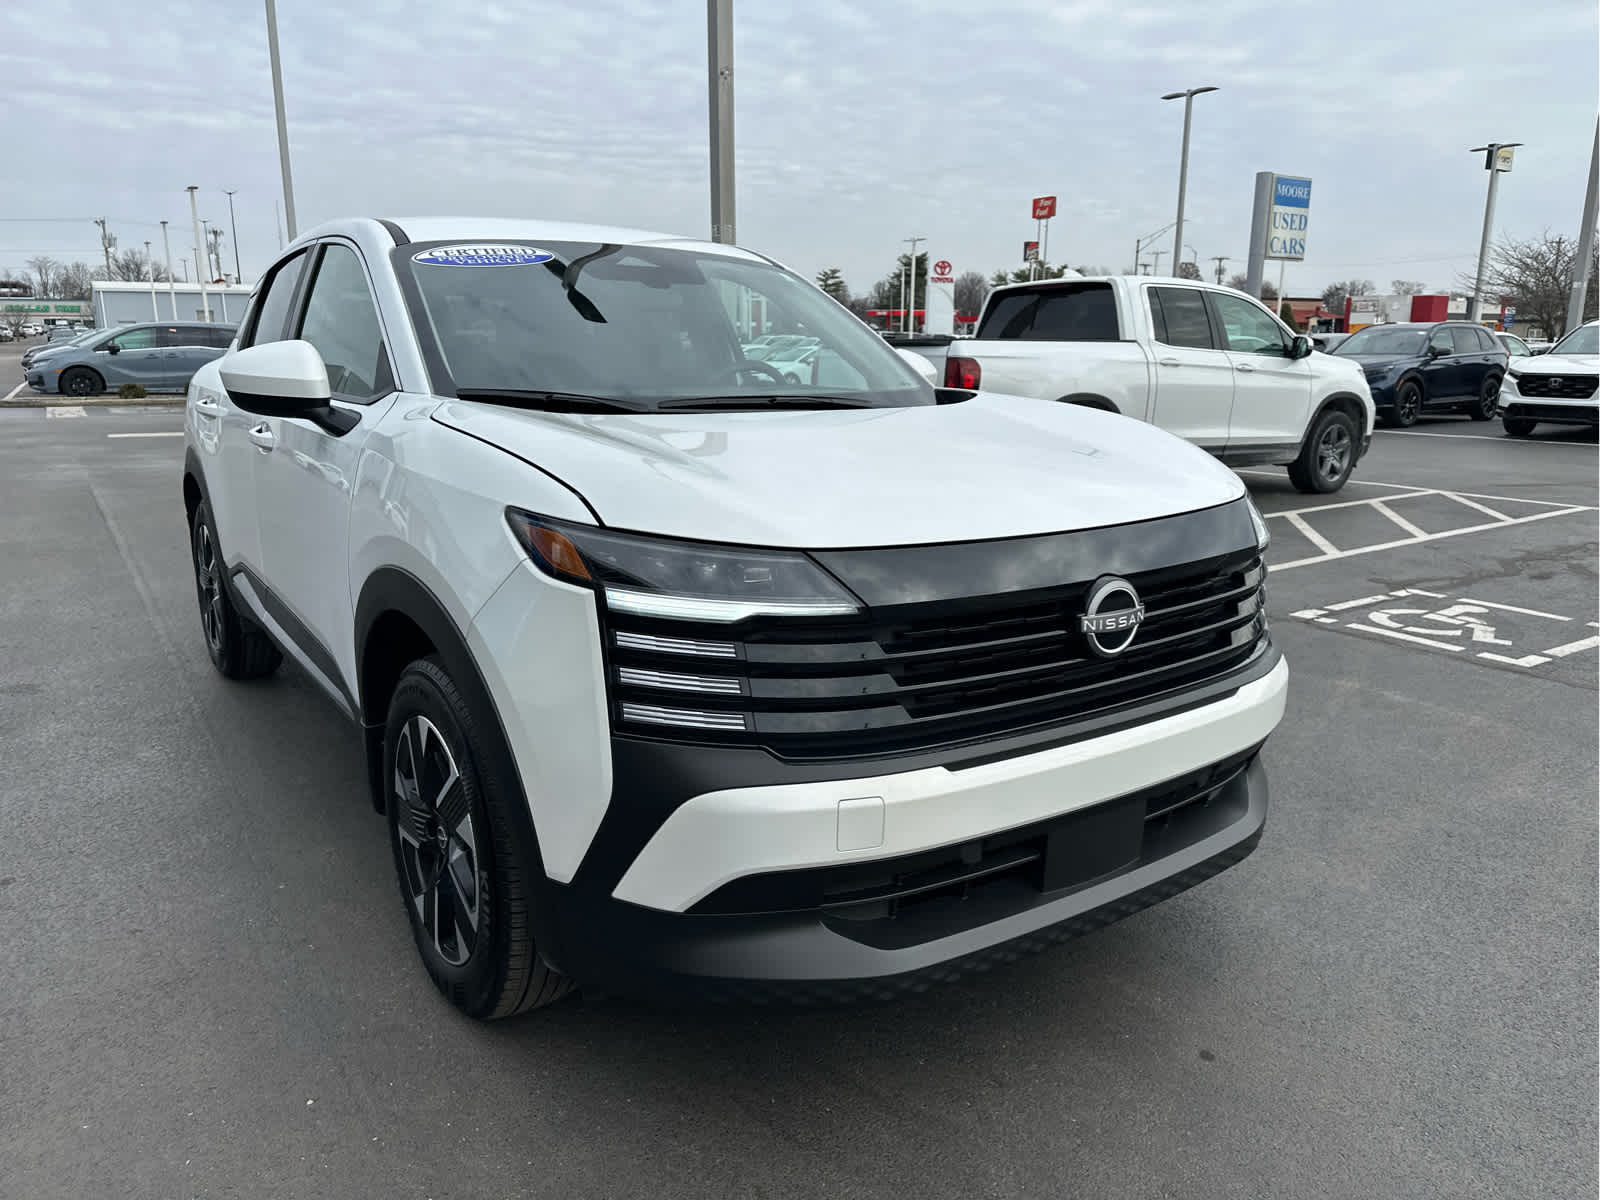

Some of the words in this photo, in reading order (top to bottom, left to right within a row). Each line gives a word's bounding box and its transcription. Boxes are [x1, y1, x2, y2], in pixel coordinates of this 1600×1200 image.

[1278, 184, 1310, 200] MOORE
[1273, 212, 1308, 231] USED
[428, 248, 537, 258] CERTIFIED
[1270, 236, 1305, 255] CARS
[55, 304, 80, 313] TREE
[1083, 609, 1144, 631] NISSAN
